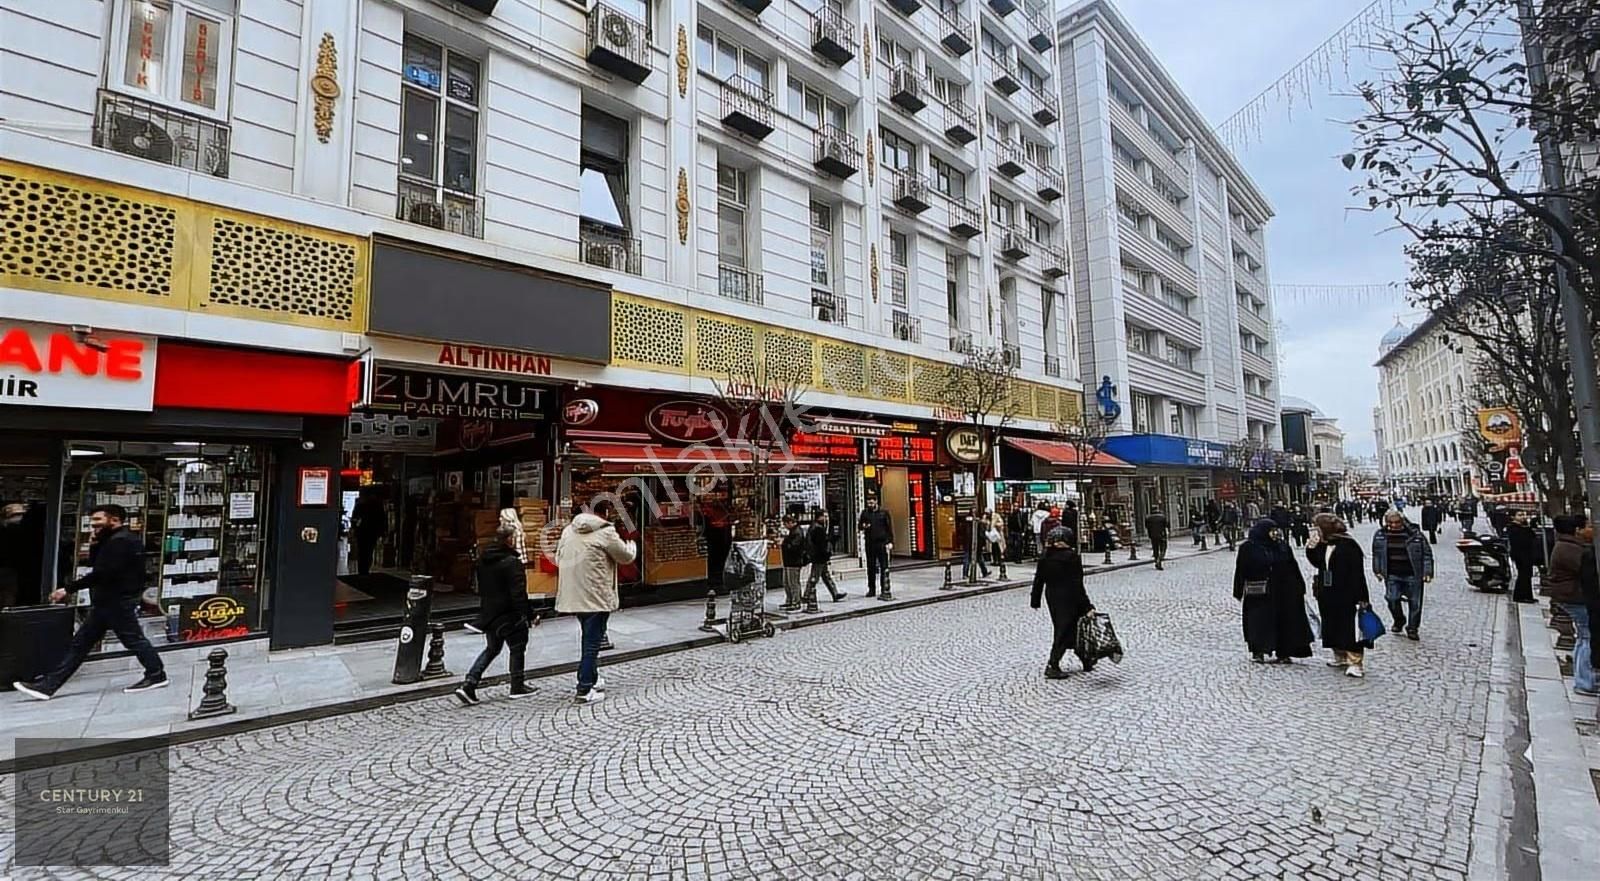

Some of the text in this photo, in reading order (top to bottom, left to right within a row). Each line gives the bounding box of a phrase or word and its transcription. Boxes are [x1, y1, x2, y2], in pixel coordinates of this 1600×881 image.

[0, 327, 144, 382] ANE
[438, 343, 551, 375] ALTINHAN
[404, 402, 518, 420] PARFUMERI
[190, 606, 245, 620] SOLGAR
